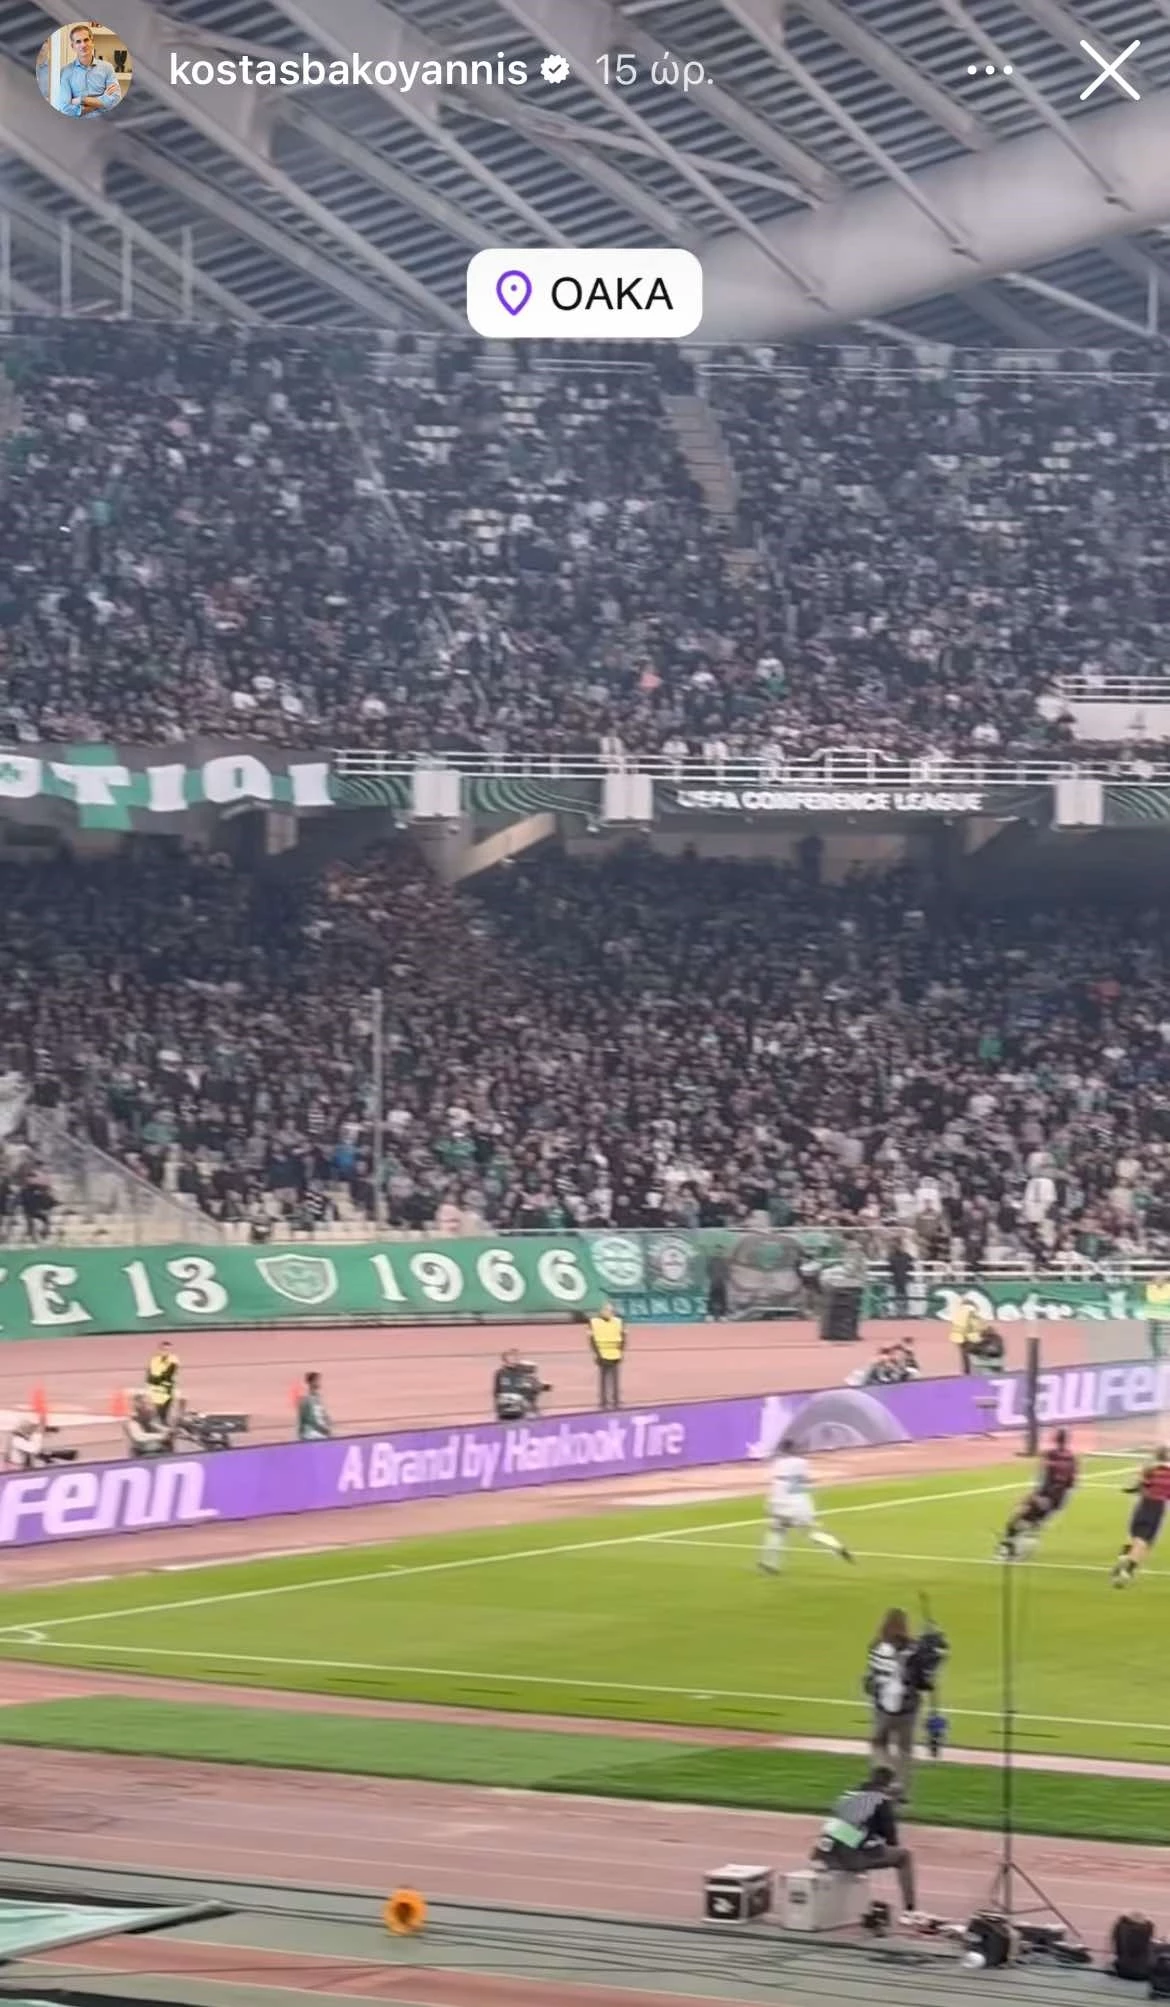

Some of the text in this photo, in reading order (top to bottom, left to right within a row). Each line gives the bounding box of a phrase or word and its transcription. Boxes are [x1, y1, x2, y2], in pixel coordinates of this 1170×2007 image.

[677, 790, 986, 812] UEFA CONFERENCE LEAGUE
[121, 1256, 229, 1318] 13
[368, 1249, 588, 1302] 1966
[338, 1413, 686, 1492] A Brand by Hankook Tire
